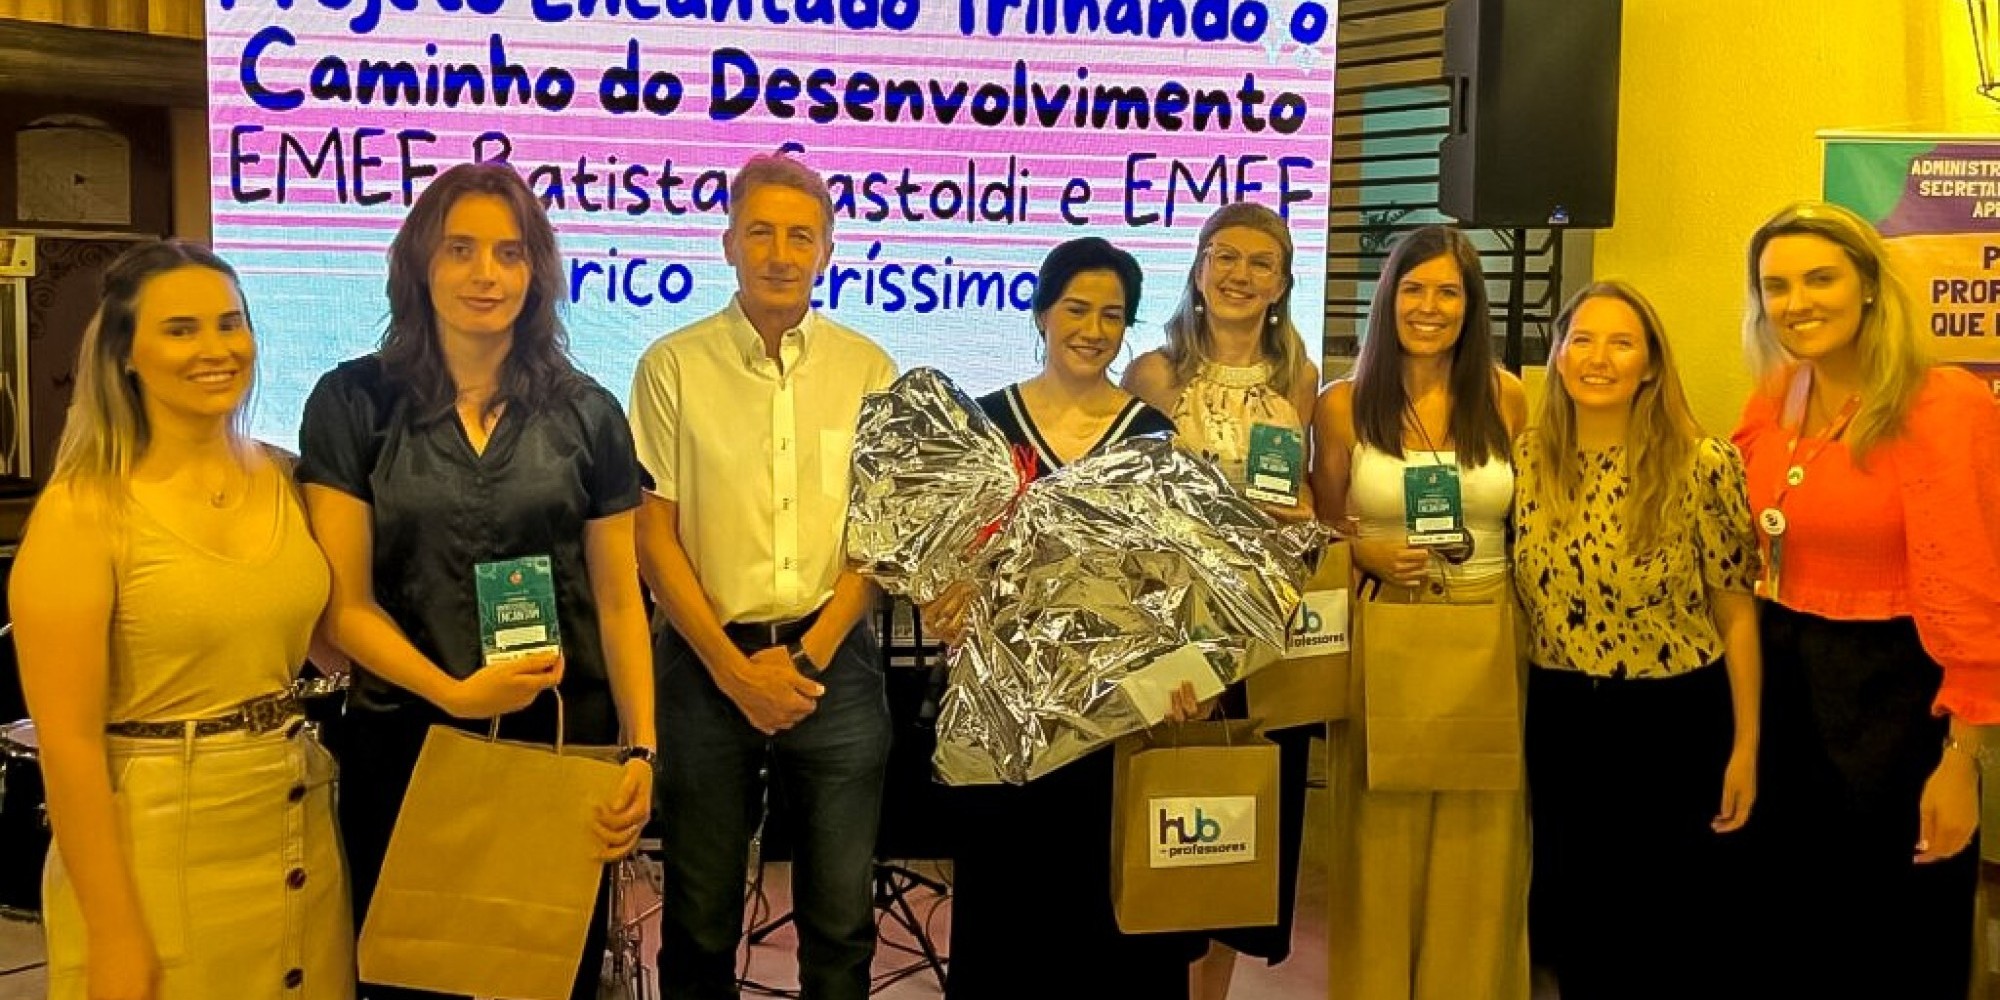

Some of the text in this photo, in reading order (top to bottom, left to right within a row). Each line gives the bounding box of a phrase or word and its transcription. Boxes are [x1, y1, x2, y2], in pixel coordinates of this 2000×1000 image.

[1290, 1, 1328, 45] o
[241, 26, 1308, 133] Caminho do Desenvolvimento
[231, 125, 437, 206] EMEF
[772, 142, 1029, 223] astoldi
[1061, 178, 1091, 225] e
[1911, 159, 2000, 177] ADMINISTR
[571, 241, 1039, 314] rico ríssimo
[1931, 312, 1985, 337] QUE
[1159, 807, 1222, 845] hub
[1169, 843, 1246, 859] professores
